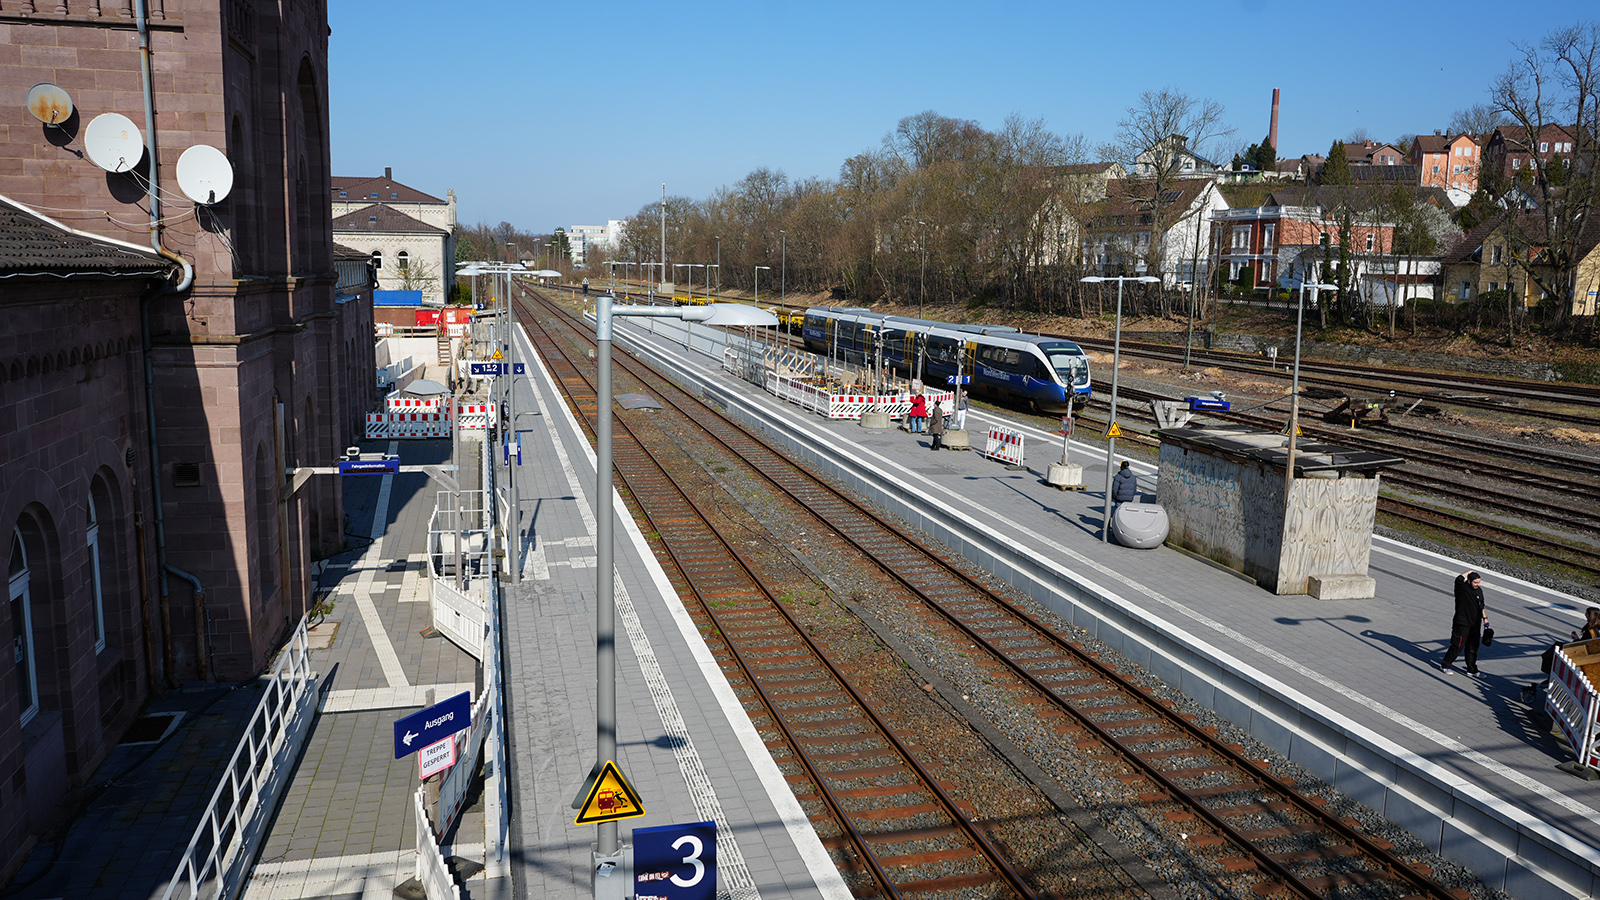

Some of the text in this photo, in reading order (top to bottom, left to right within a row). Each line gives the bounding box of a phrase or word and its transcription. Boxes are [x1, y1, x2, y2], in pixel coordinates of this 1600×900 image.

[482, 364, 486, 372] 1
[492, 364, 498, 372] 2
[948, 375, 955, 383] 2
[1177, 463, 1236, 492] AUSGANG
[424, 711, 454, 731] Ausgang
[426, 742, 446, 757] TREPPE
[423, 751, 450, 769] GESPERRT
[669, 835, 705, 888] 3
